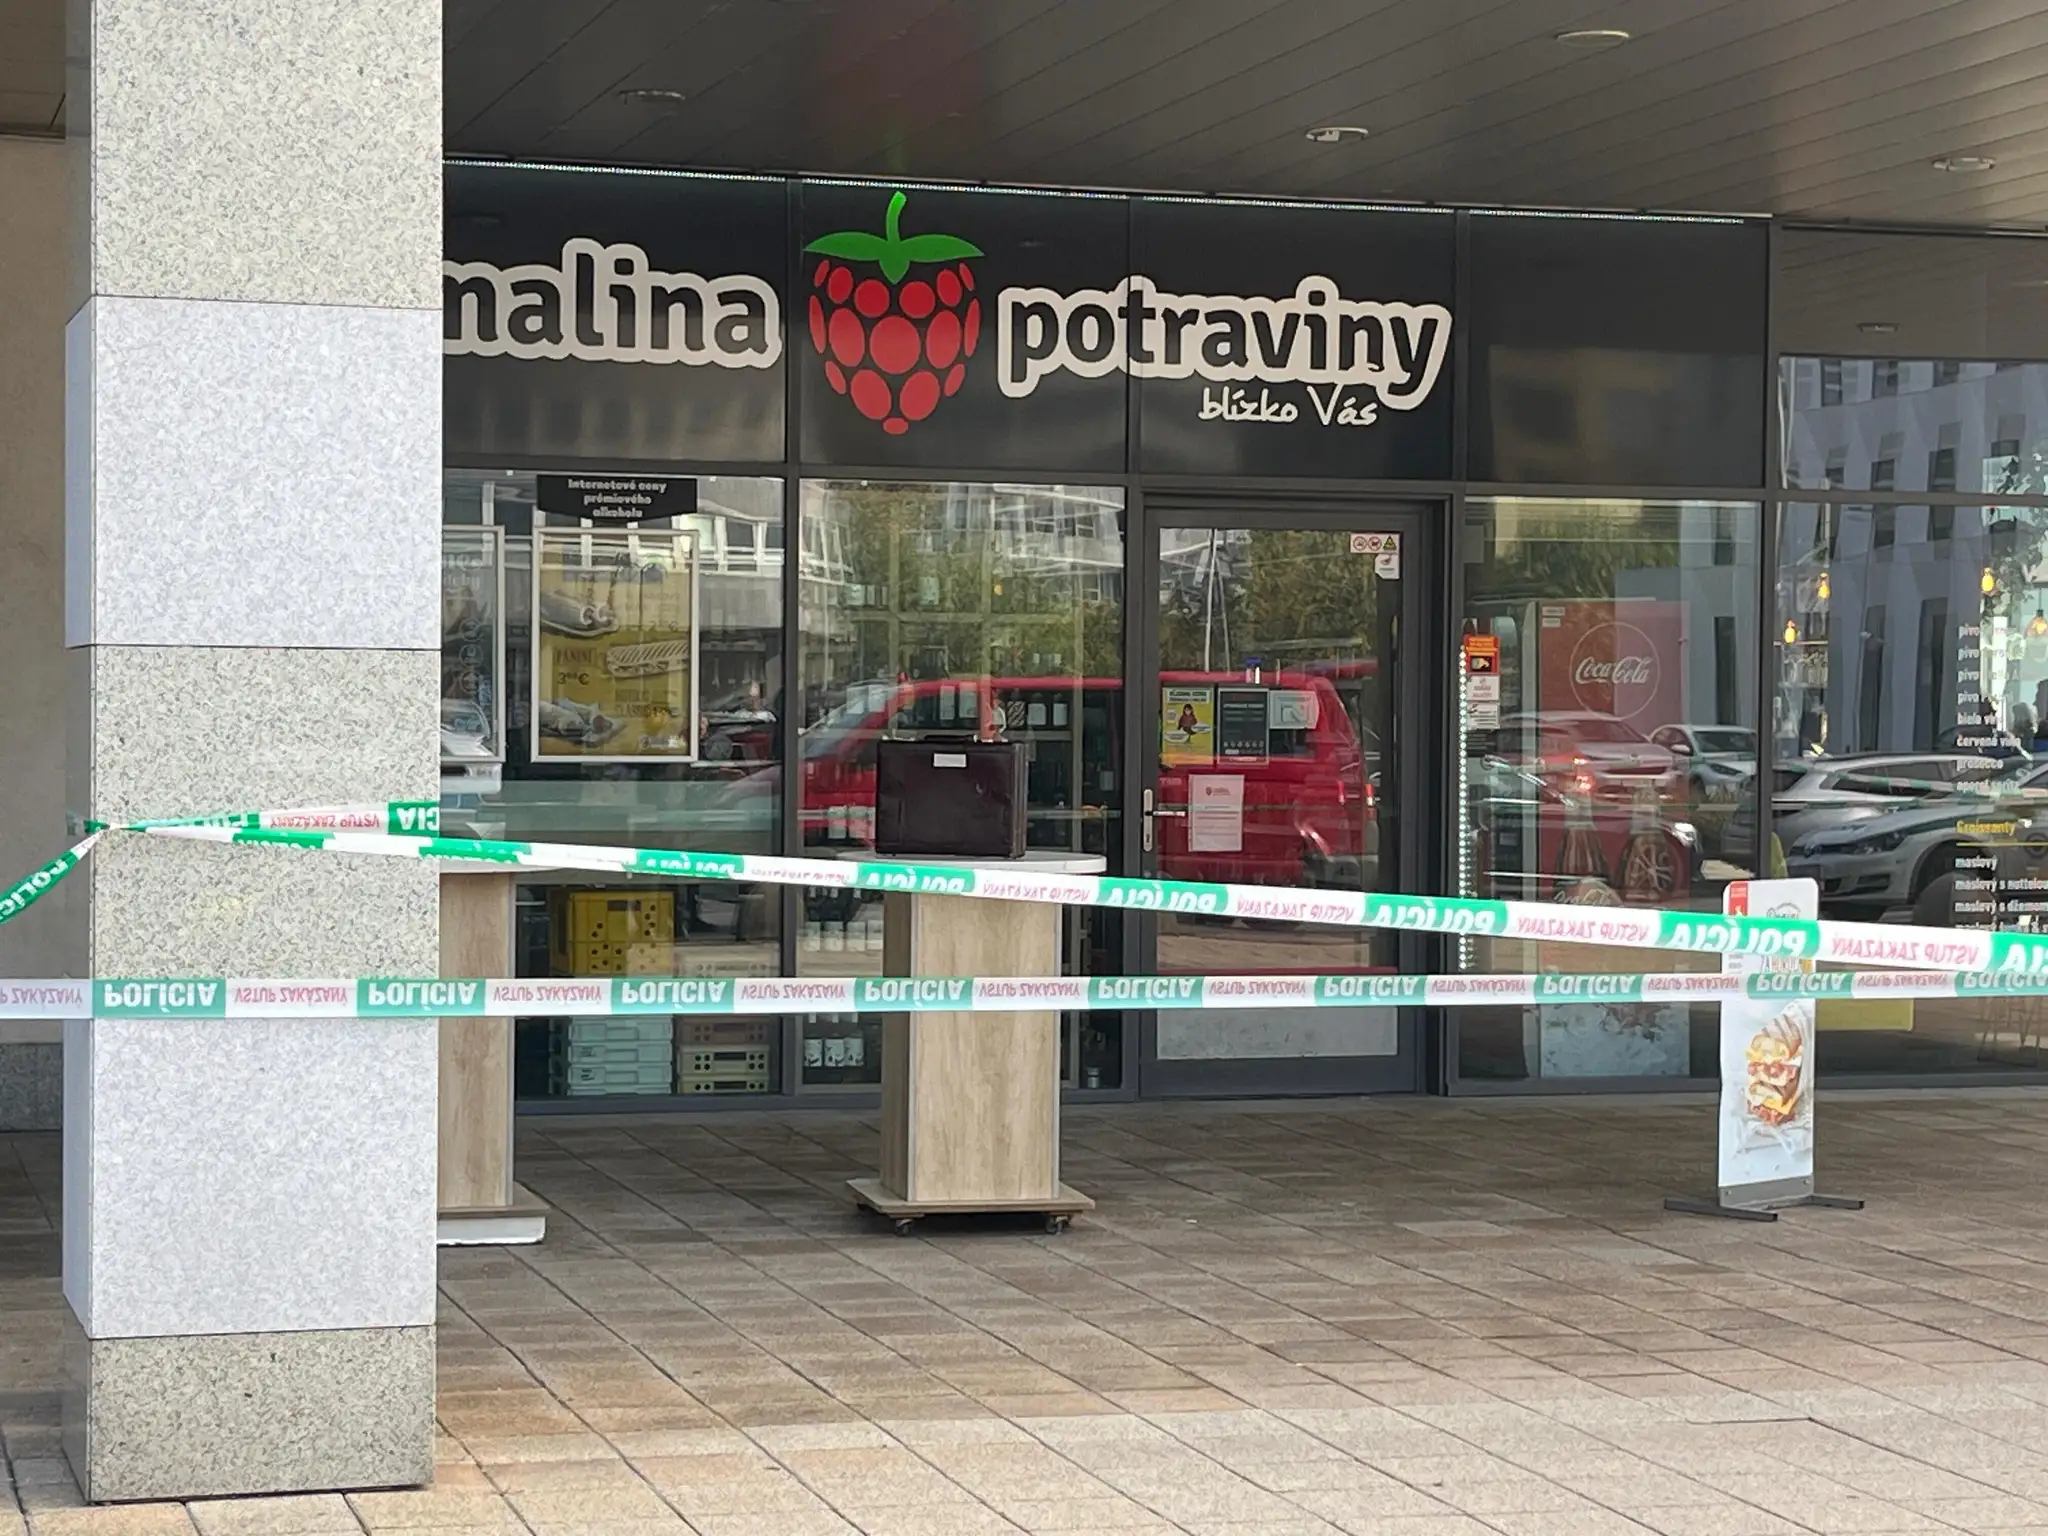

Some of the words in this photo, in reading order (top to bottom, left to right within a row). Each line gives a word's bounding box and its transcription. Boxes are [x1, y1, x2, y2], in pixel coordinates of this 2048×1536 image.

[1003, 280, 1446, 405] potraviny
[1198, 388, 1298, 423] blízko
[1307, 384, 1378, 426] Vás
